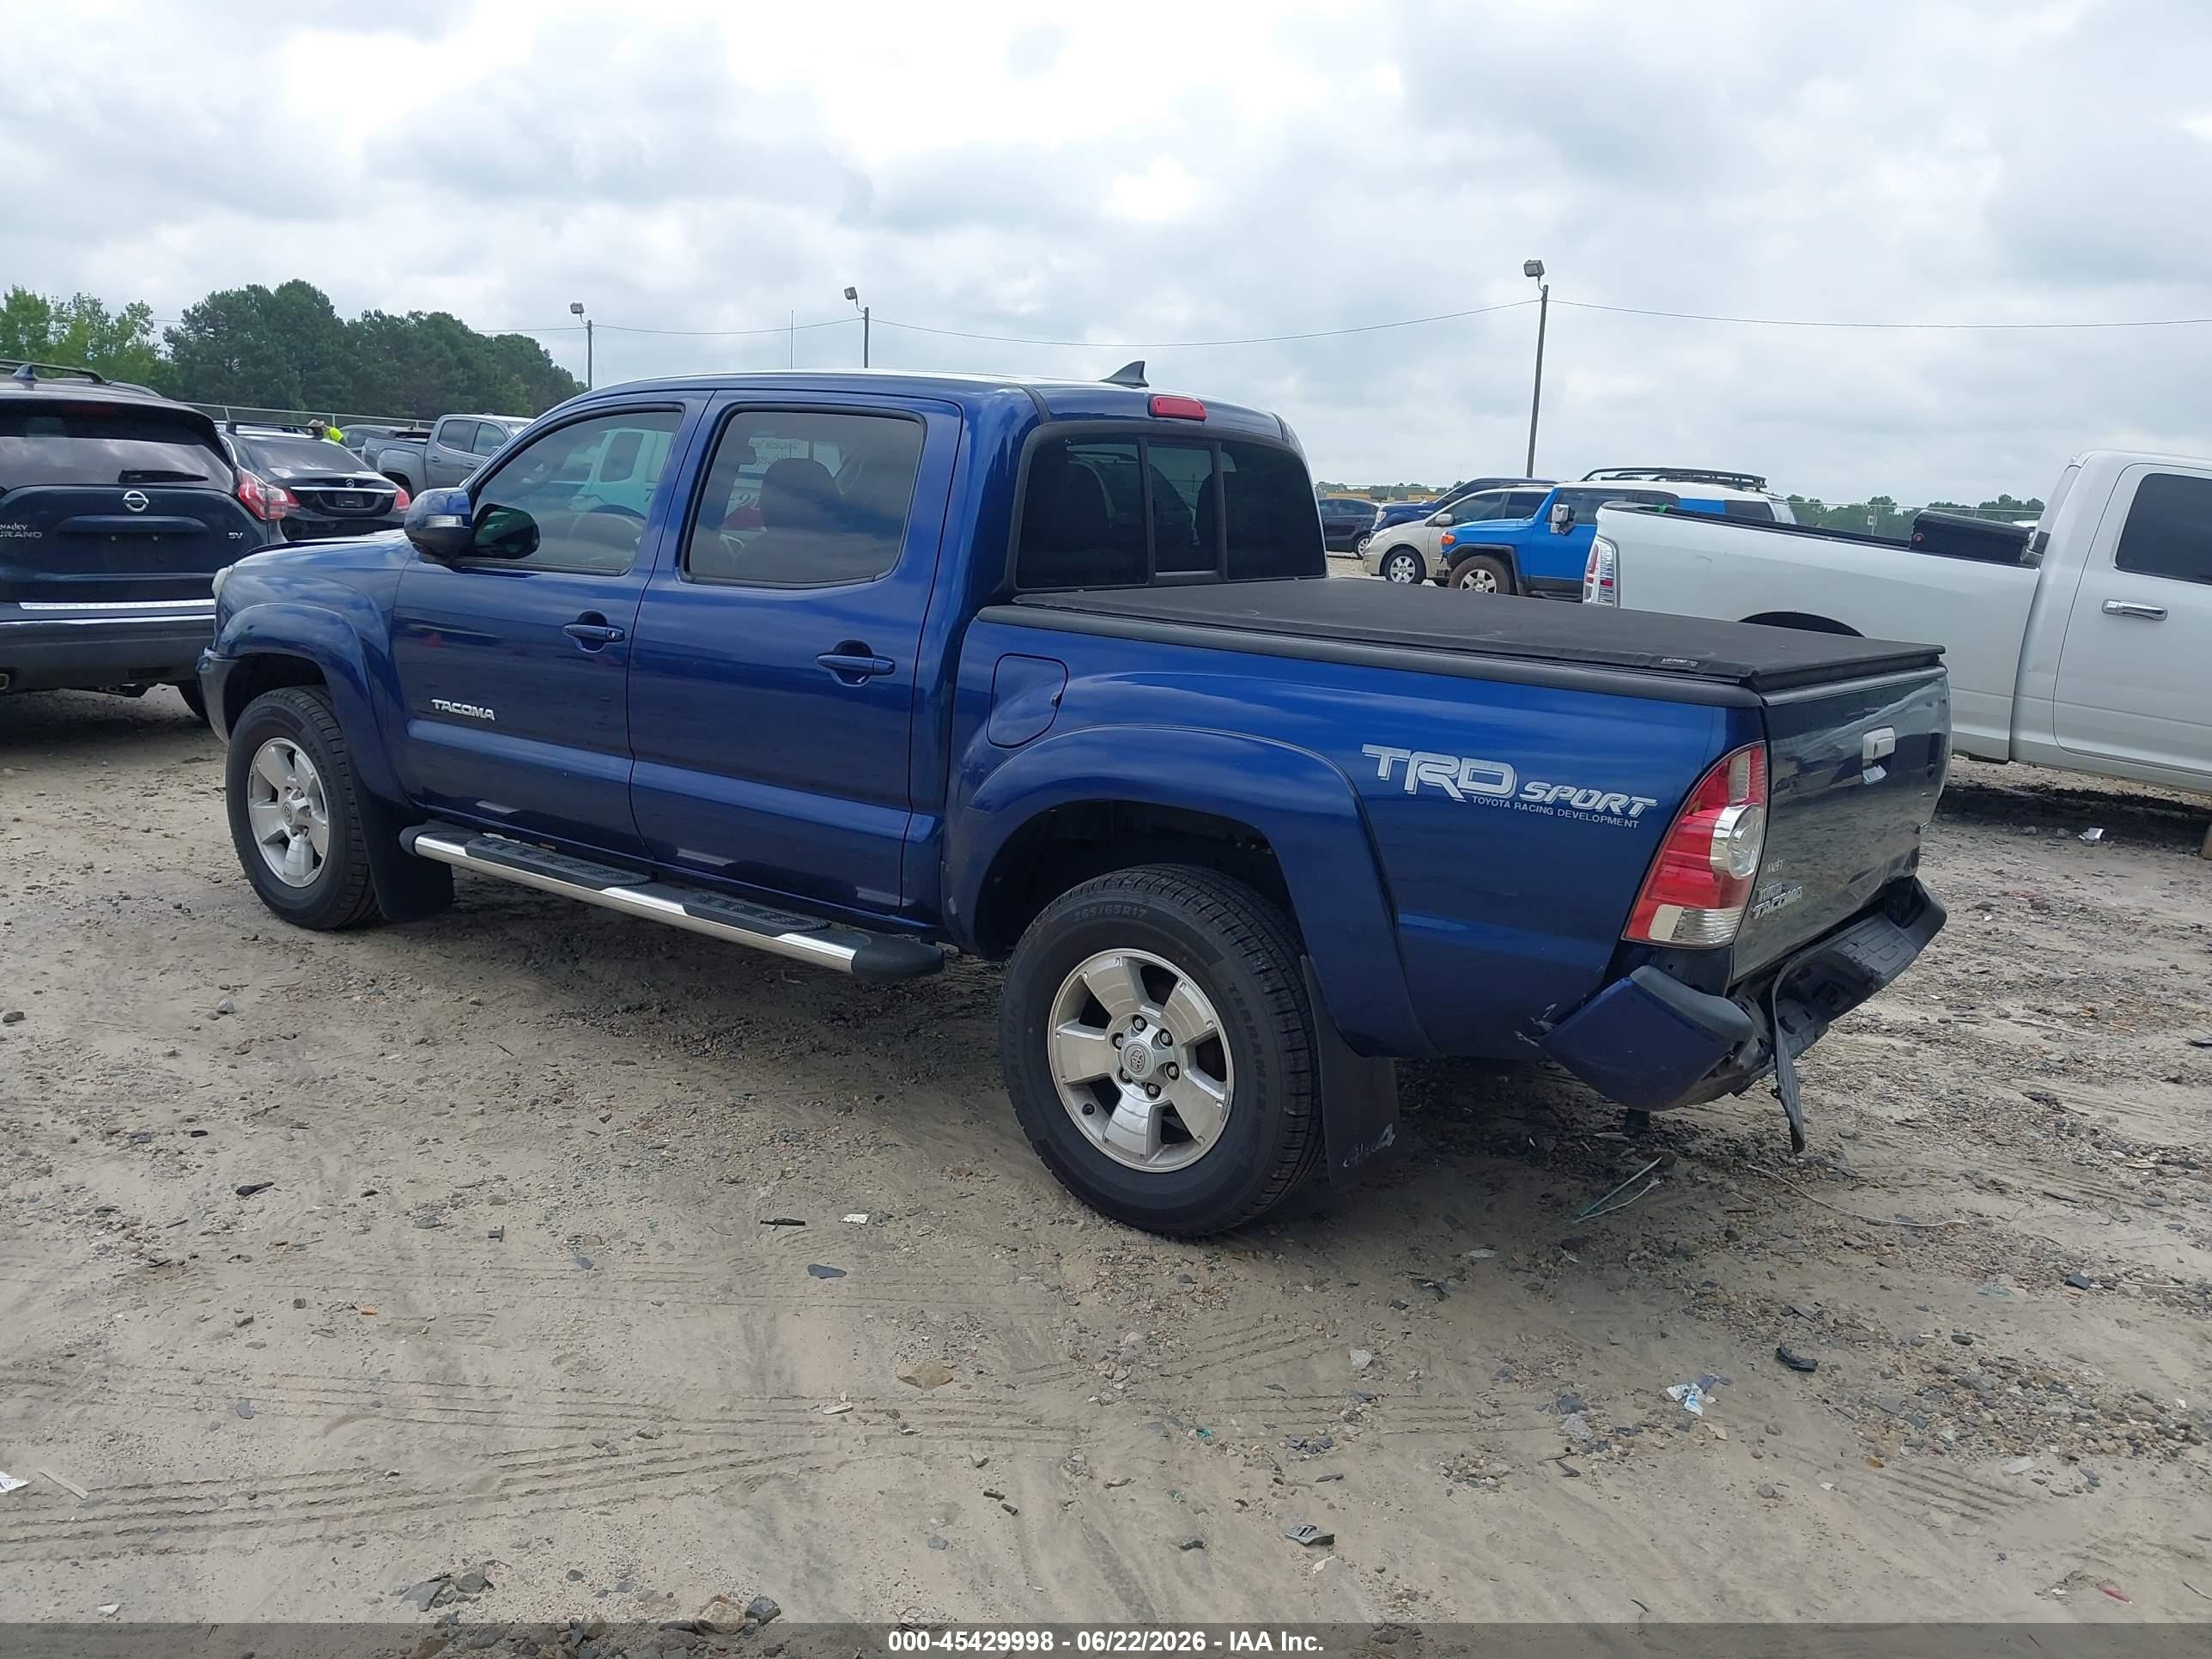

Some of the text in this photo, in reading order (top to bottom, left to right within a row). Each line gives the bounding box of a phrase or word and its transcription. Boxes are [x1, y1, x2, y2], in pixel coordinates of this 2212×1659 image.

[430, 698, 495, 721] TACOMA
[1362, 744, 1658, 817] TRD SPORT
[1472, 795, 1640, 829] TOYOTA RACING DEVELOPMENT
